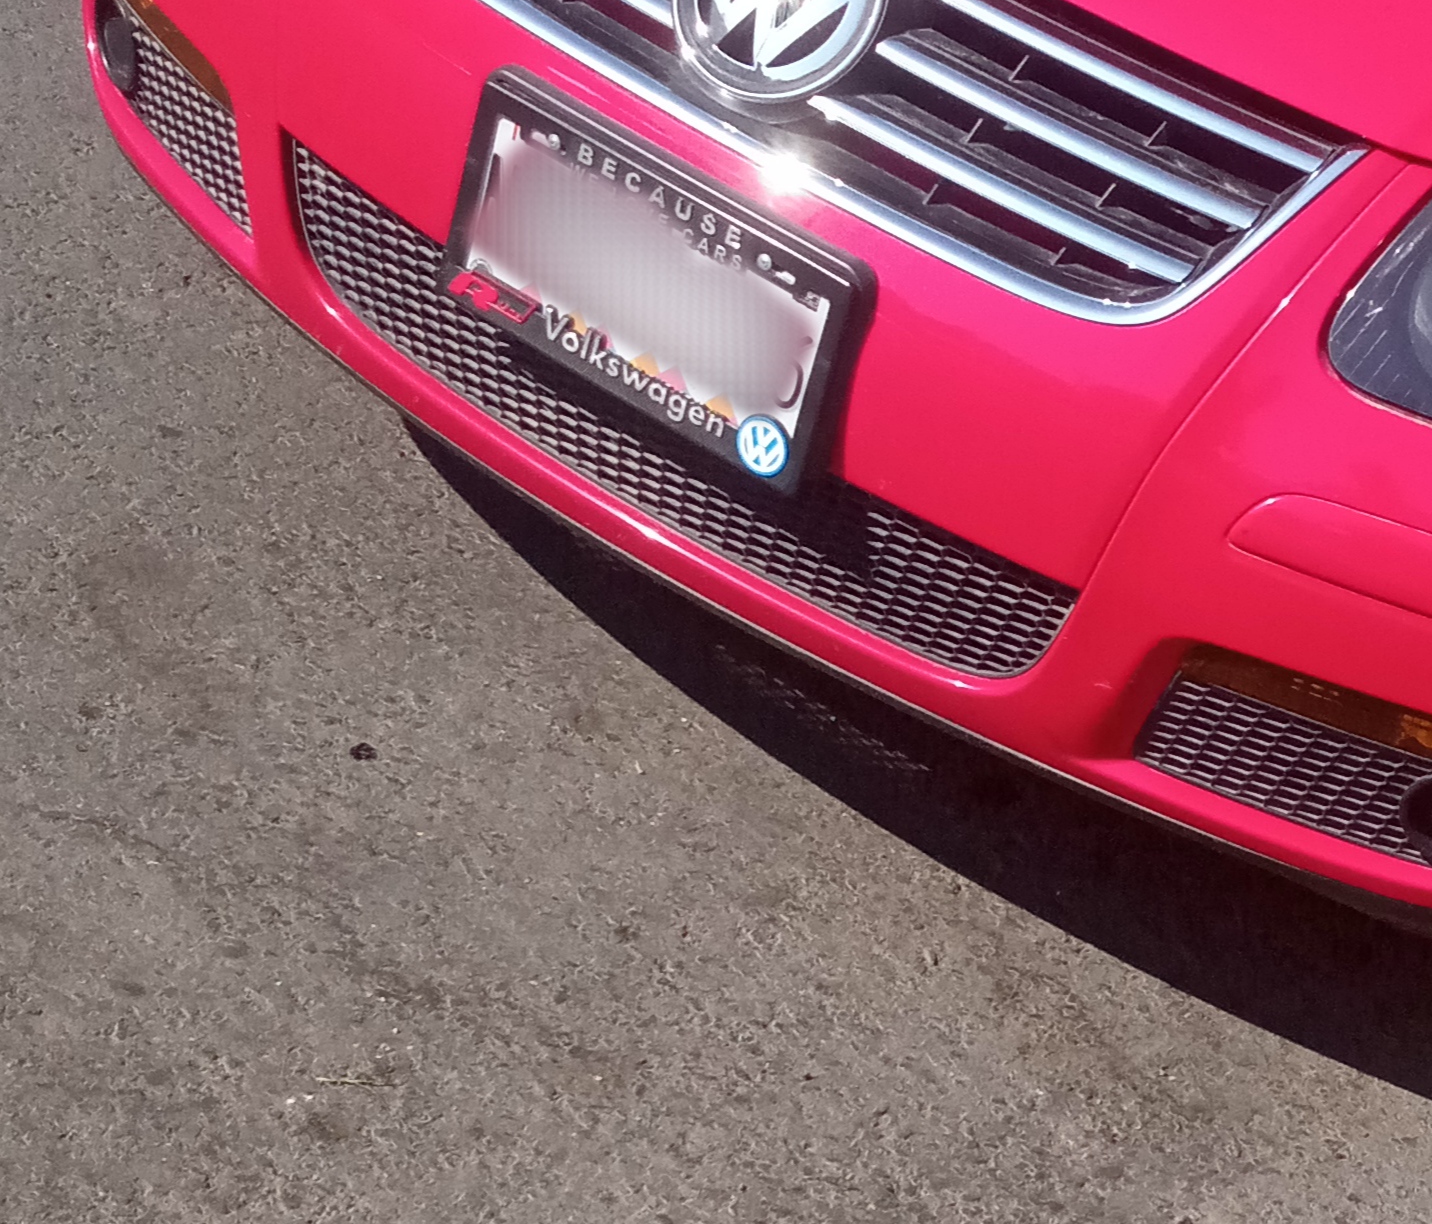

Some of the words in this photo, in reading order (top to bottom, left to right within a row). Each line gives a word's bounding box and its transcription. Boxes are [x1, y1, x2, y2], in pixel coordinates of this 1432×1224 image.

[577, 143, 742, 250] BECAUSE
[682, 228, 743, 270] CARS
[543, 306, 725, 438] Volkswagen
[737, 415, 789, 477] VW
